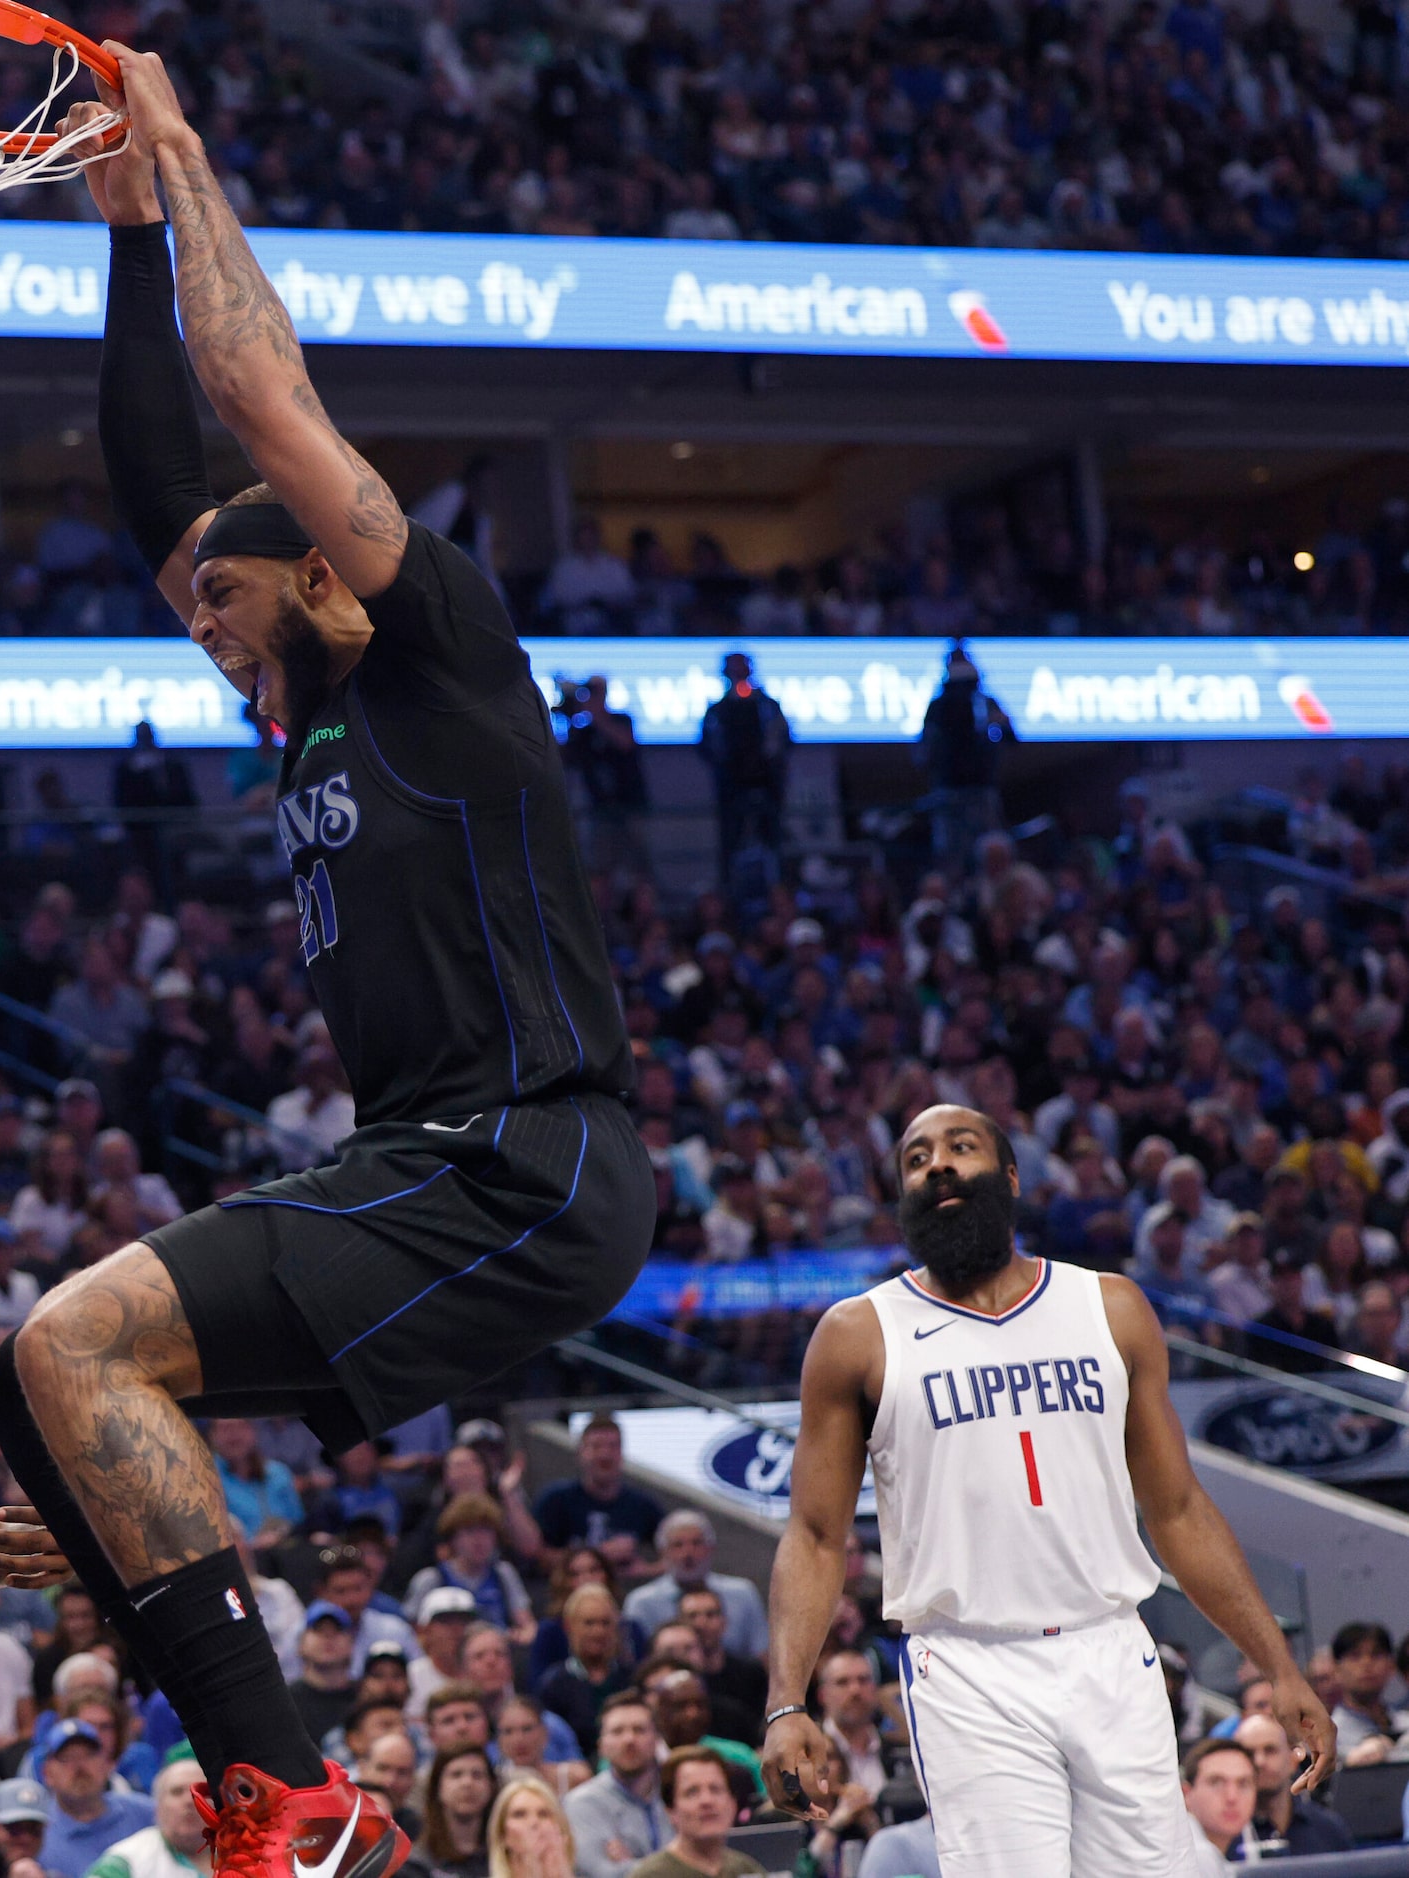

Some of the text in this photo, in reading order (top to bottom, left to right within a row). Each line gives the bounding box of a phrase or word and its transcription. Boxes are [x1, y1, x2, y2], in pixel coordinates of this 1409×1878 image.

[373, 275, 469, 325] we
[664, 271, 927, 336] American
[1107, 279, 1409, 356] You are wh
[763, 675, 853, 724] we
[1024, 665, 1261, 722] American
[277, 770, 360, 854] AVS
[294, 857, 339, 967] 21
[921, 1356, 1105, 1430] CLIPPERS
[1019, 1431, 1044, 1507] 1
